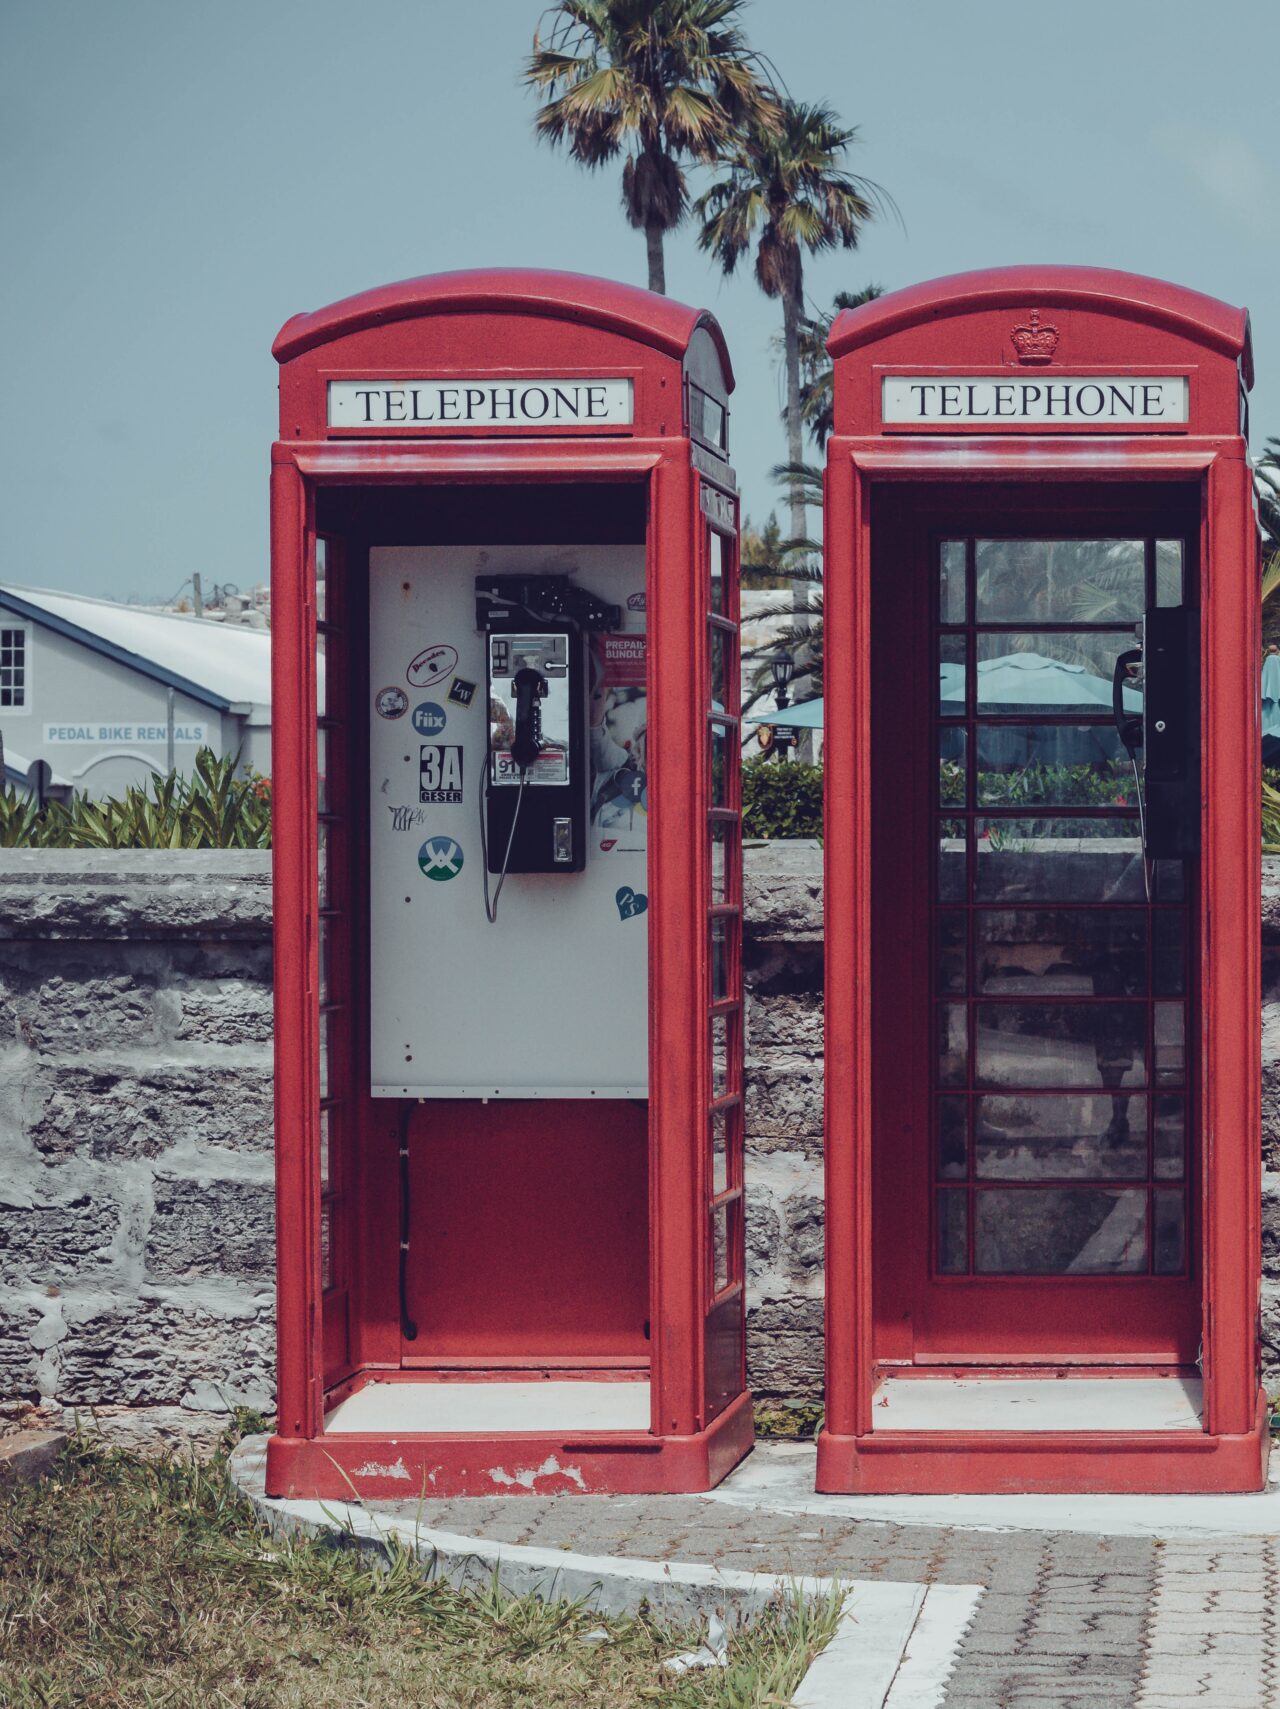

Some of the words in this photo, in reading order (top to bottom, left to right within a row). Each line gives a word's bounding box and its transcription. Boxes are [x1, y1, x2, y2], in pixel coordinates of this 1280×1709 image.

[355, 386, 609, 422] TELEPHONE
[910, 384, 1165, 417] TELEPHONE
[605, 650, 644, 659] BUNDLE
[415, 710, 444, 728] fiix
[49, 727, 95, 740] PEDAL
[99, 727, 133, 740] BIKE
[137, 727, 203, 740] RENALS
[420, 745, 462, 791] 3A
[421, 791, 462, 802] GESER
